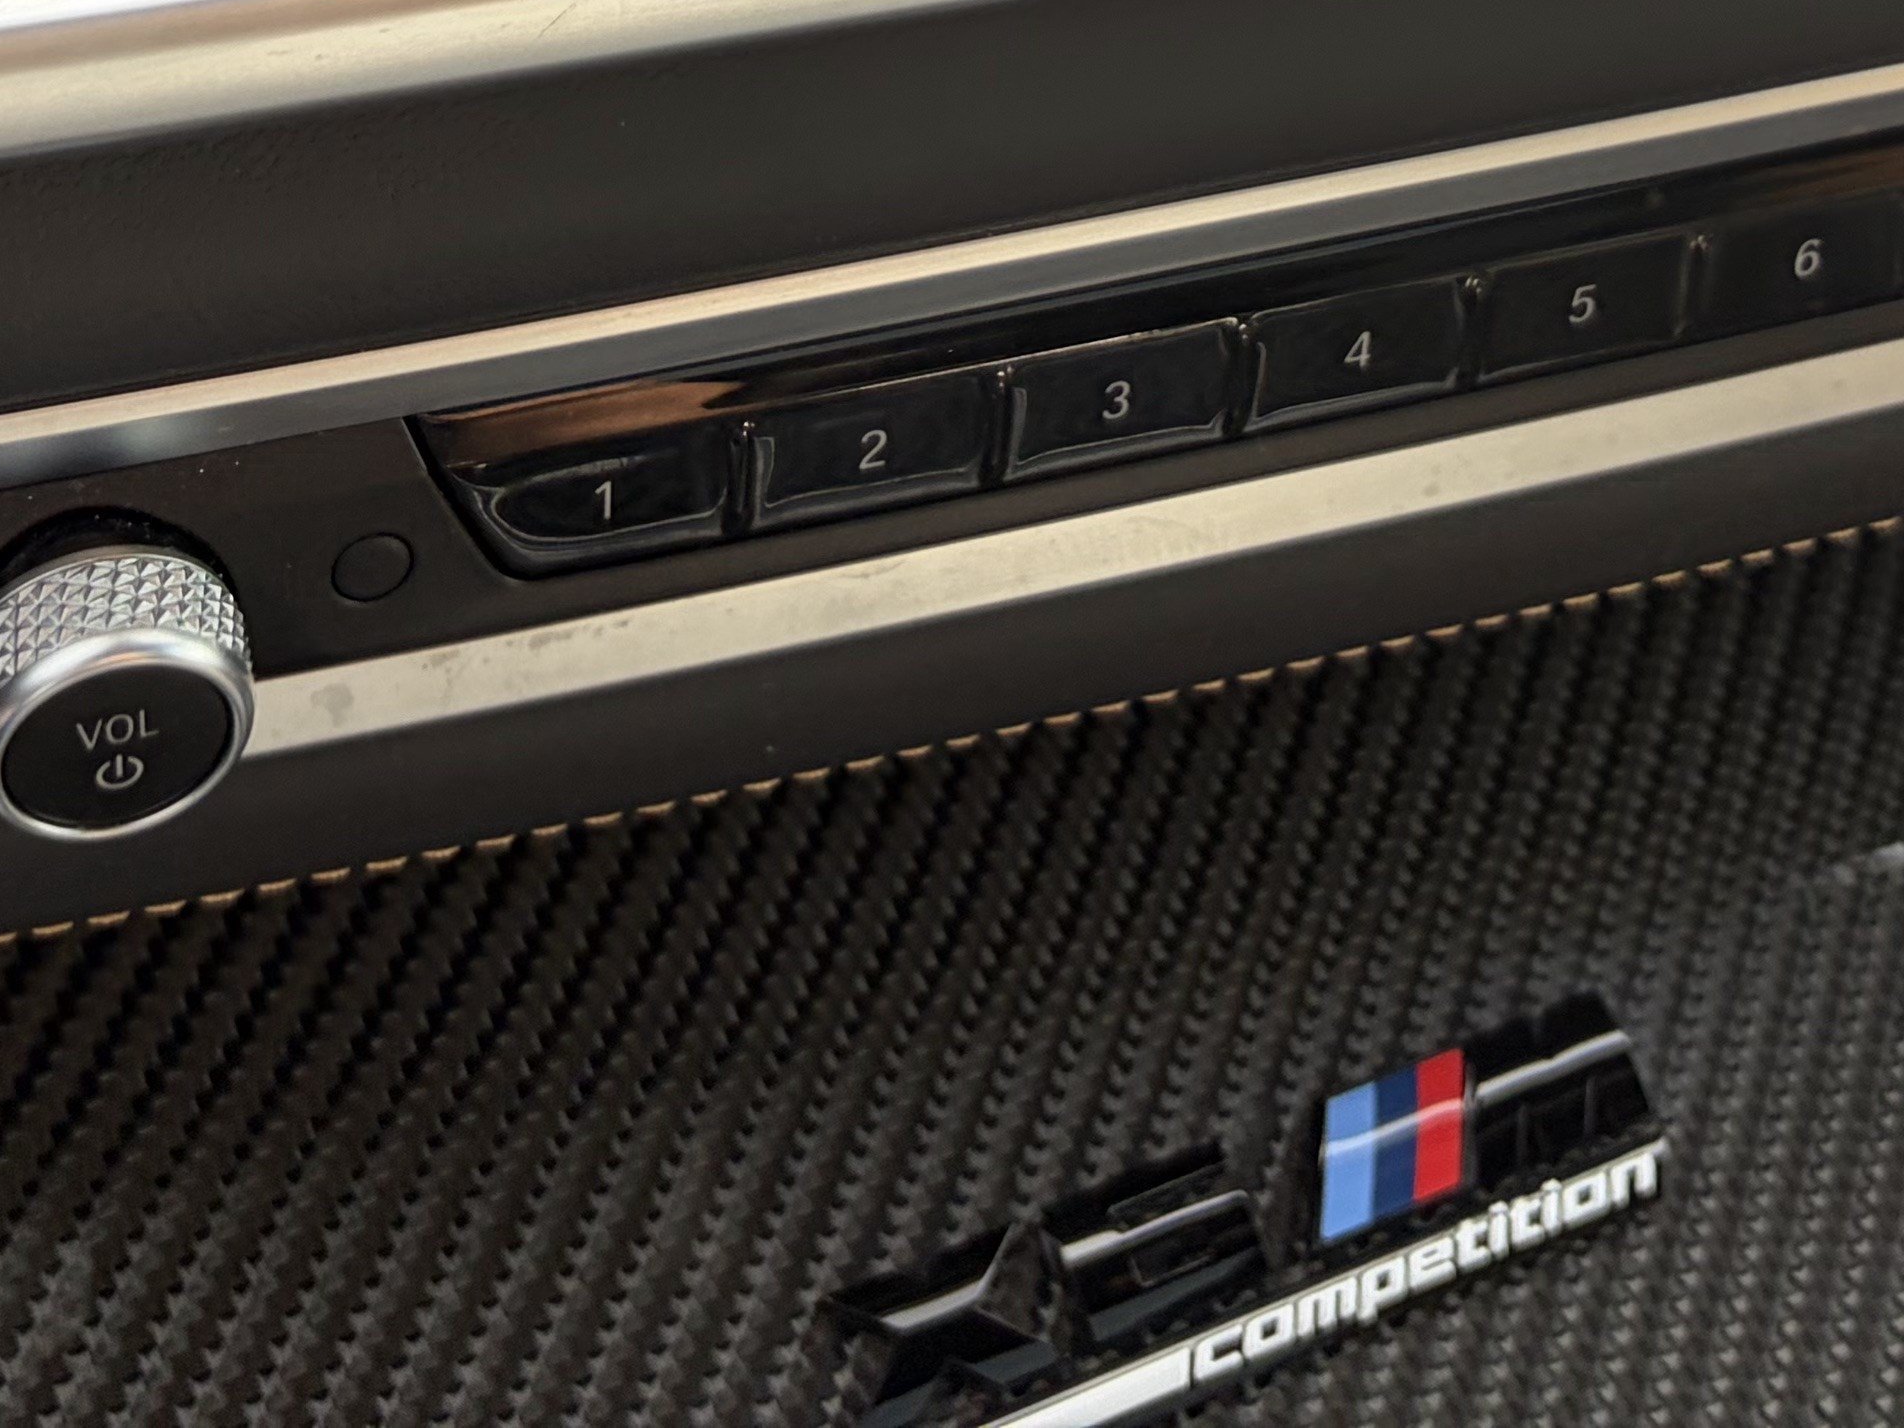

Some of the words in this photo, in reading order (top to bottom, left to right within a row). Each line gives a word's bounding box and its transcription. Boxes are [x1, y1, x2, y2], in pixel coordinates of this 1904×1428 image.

[1794, 238, 1821, 278] 6
[1568, 284, 1596, 324] 5
[1344, 330, 1371, 369] 4
[1102, 380, 1131, 420] 3
[858, 429, 888, 471] 2
[594, 481, 616, 521] 1
[75, 709, 160, 751] VOL
[1192, 1149, 1660, 1388] competition
